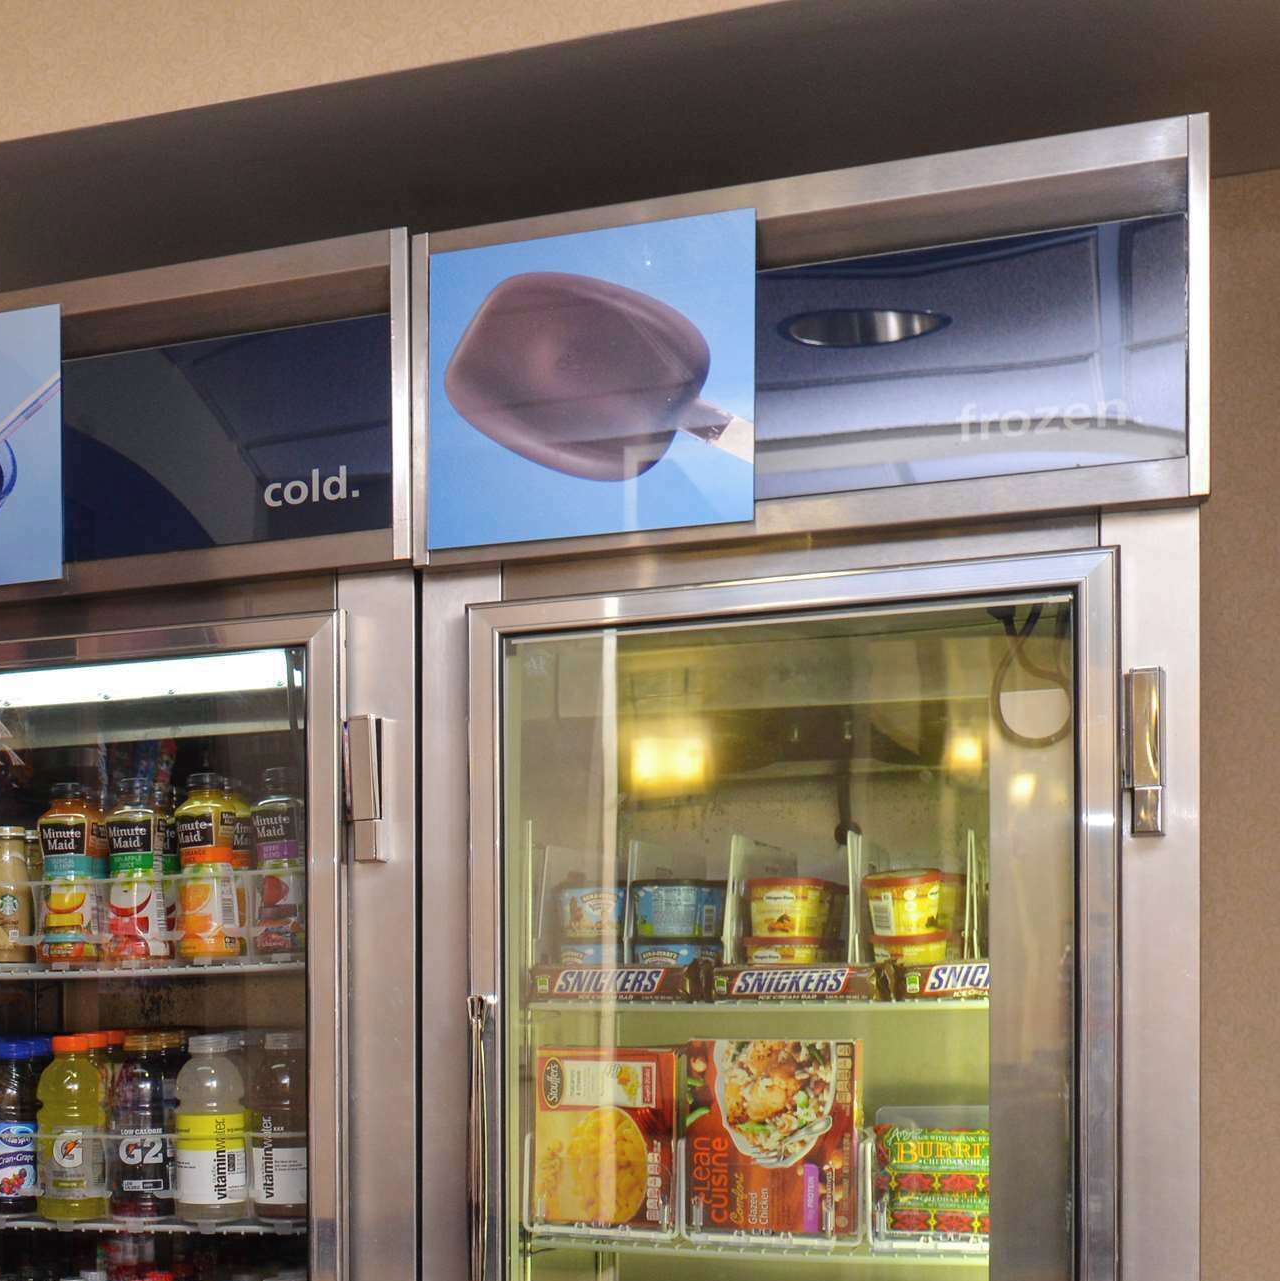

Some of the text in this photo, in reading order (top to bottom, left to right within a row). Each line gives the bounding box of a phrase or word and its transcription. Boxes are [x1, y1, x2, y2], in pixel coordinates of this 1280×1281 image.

[263, 465, 361, 508] cold.
[42, 829, 82, 840] Minute
[47, 838, 76, 851] Maid
[108, 826, 147, 838] Minute
[112, 836, 141, 850] Maid
[256, 825, 285, 838] Maid
[556, 968, 664, 993] SNICKERS
[736, 968, 846, 994] SNICKERS
[118, 1136, 164, 1165] G2
[693, 1136, 712, 1205] Lean
[759, 1186, 769, 1225] Chicken
[807, 1175, 815, 1211] PROTEIN
[748, 1191, 758, 1225] Glazed
